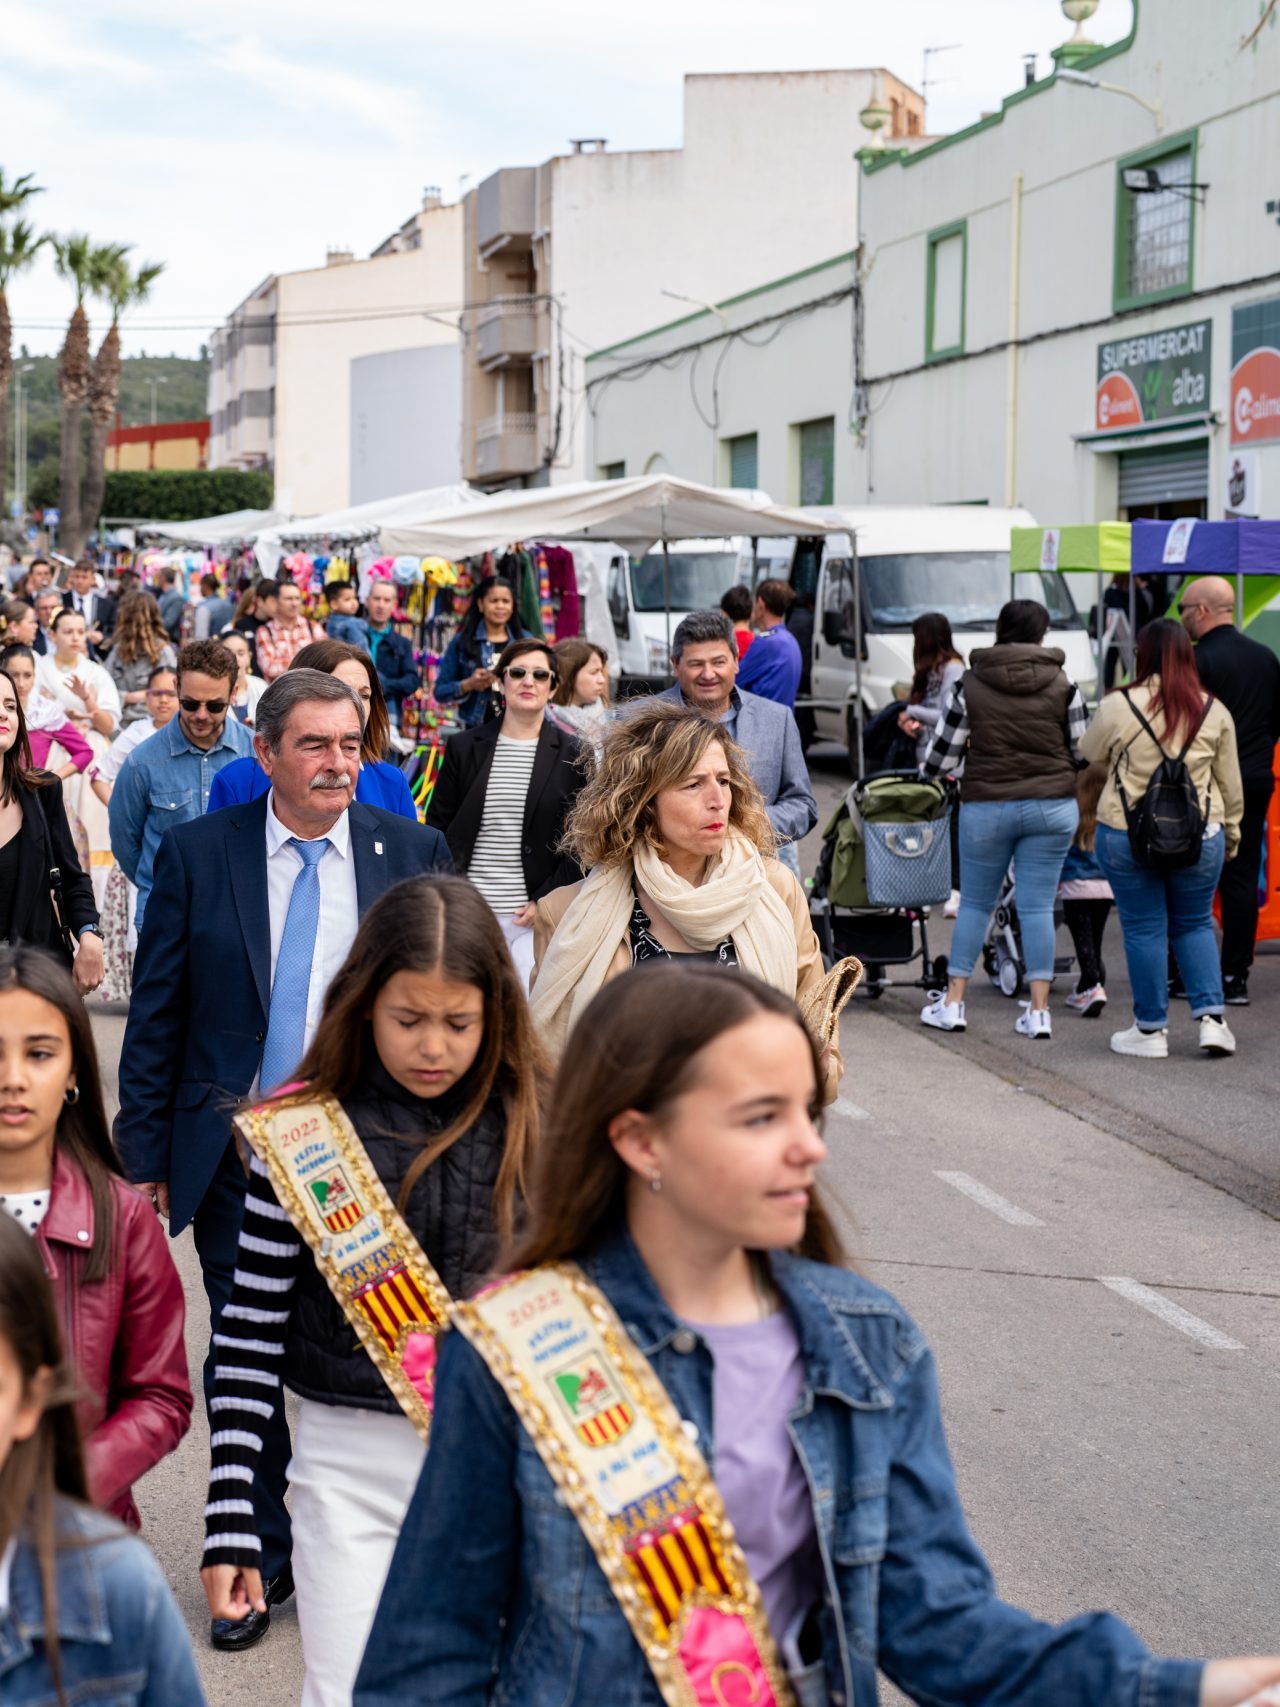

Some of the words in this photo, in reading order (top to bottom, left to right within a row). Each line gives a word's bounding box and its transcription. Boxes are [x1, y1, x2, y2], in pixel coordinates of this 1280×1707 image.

[1101, 324, 1207, 372] SUPERMERCAT
[281, 1117, 321, 1149] 2022
[506, 1287, 562, 1330] 2022
